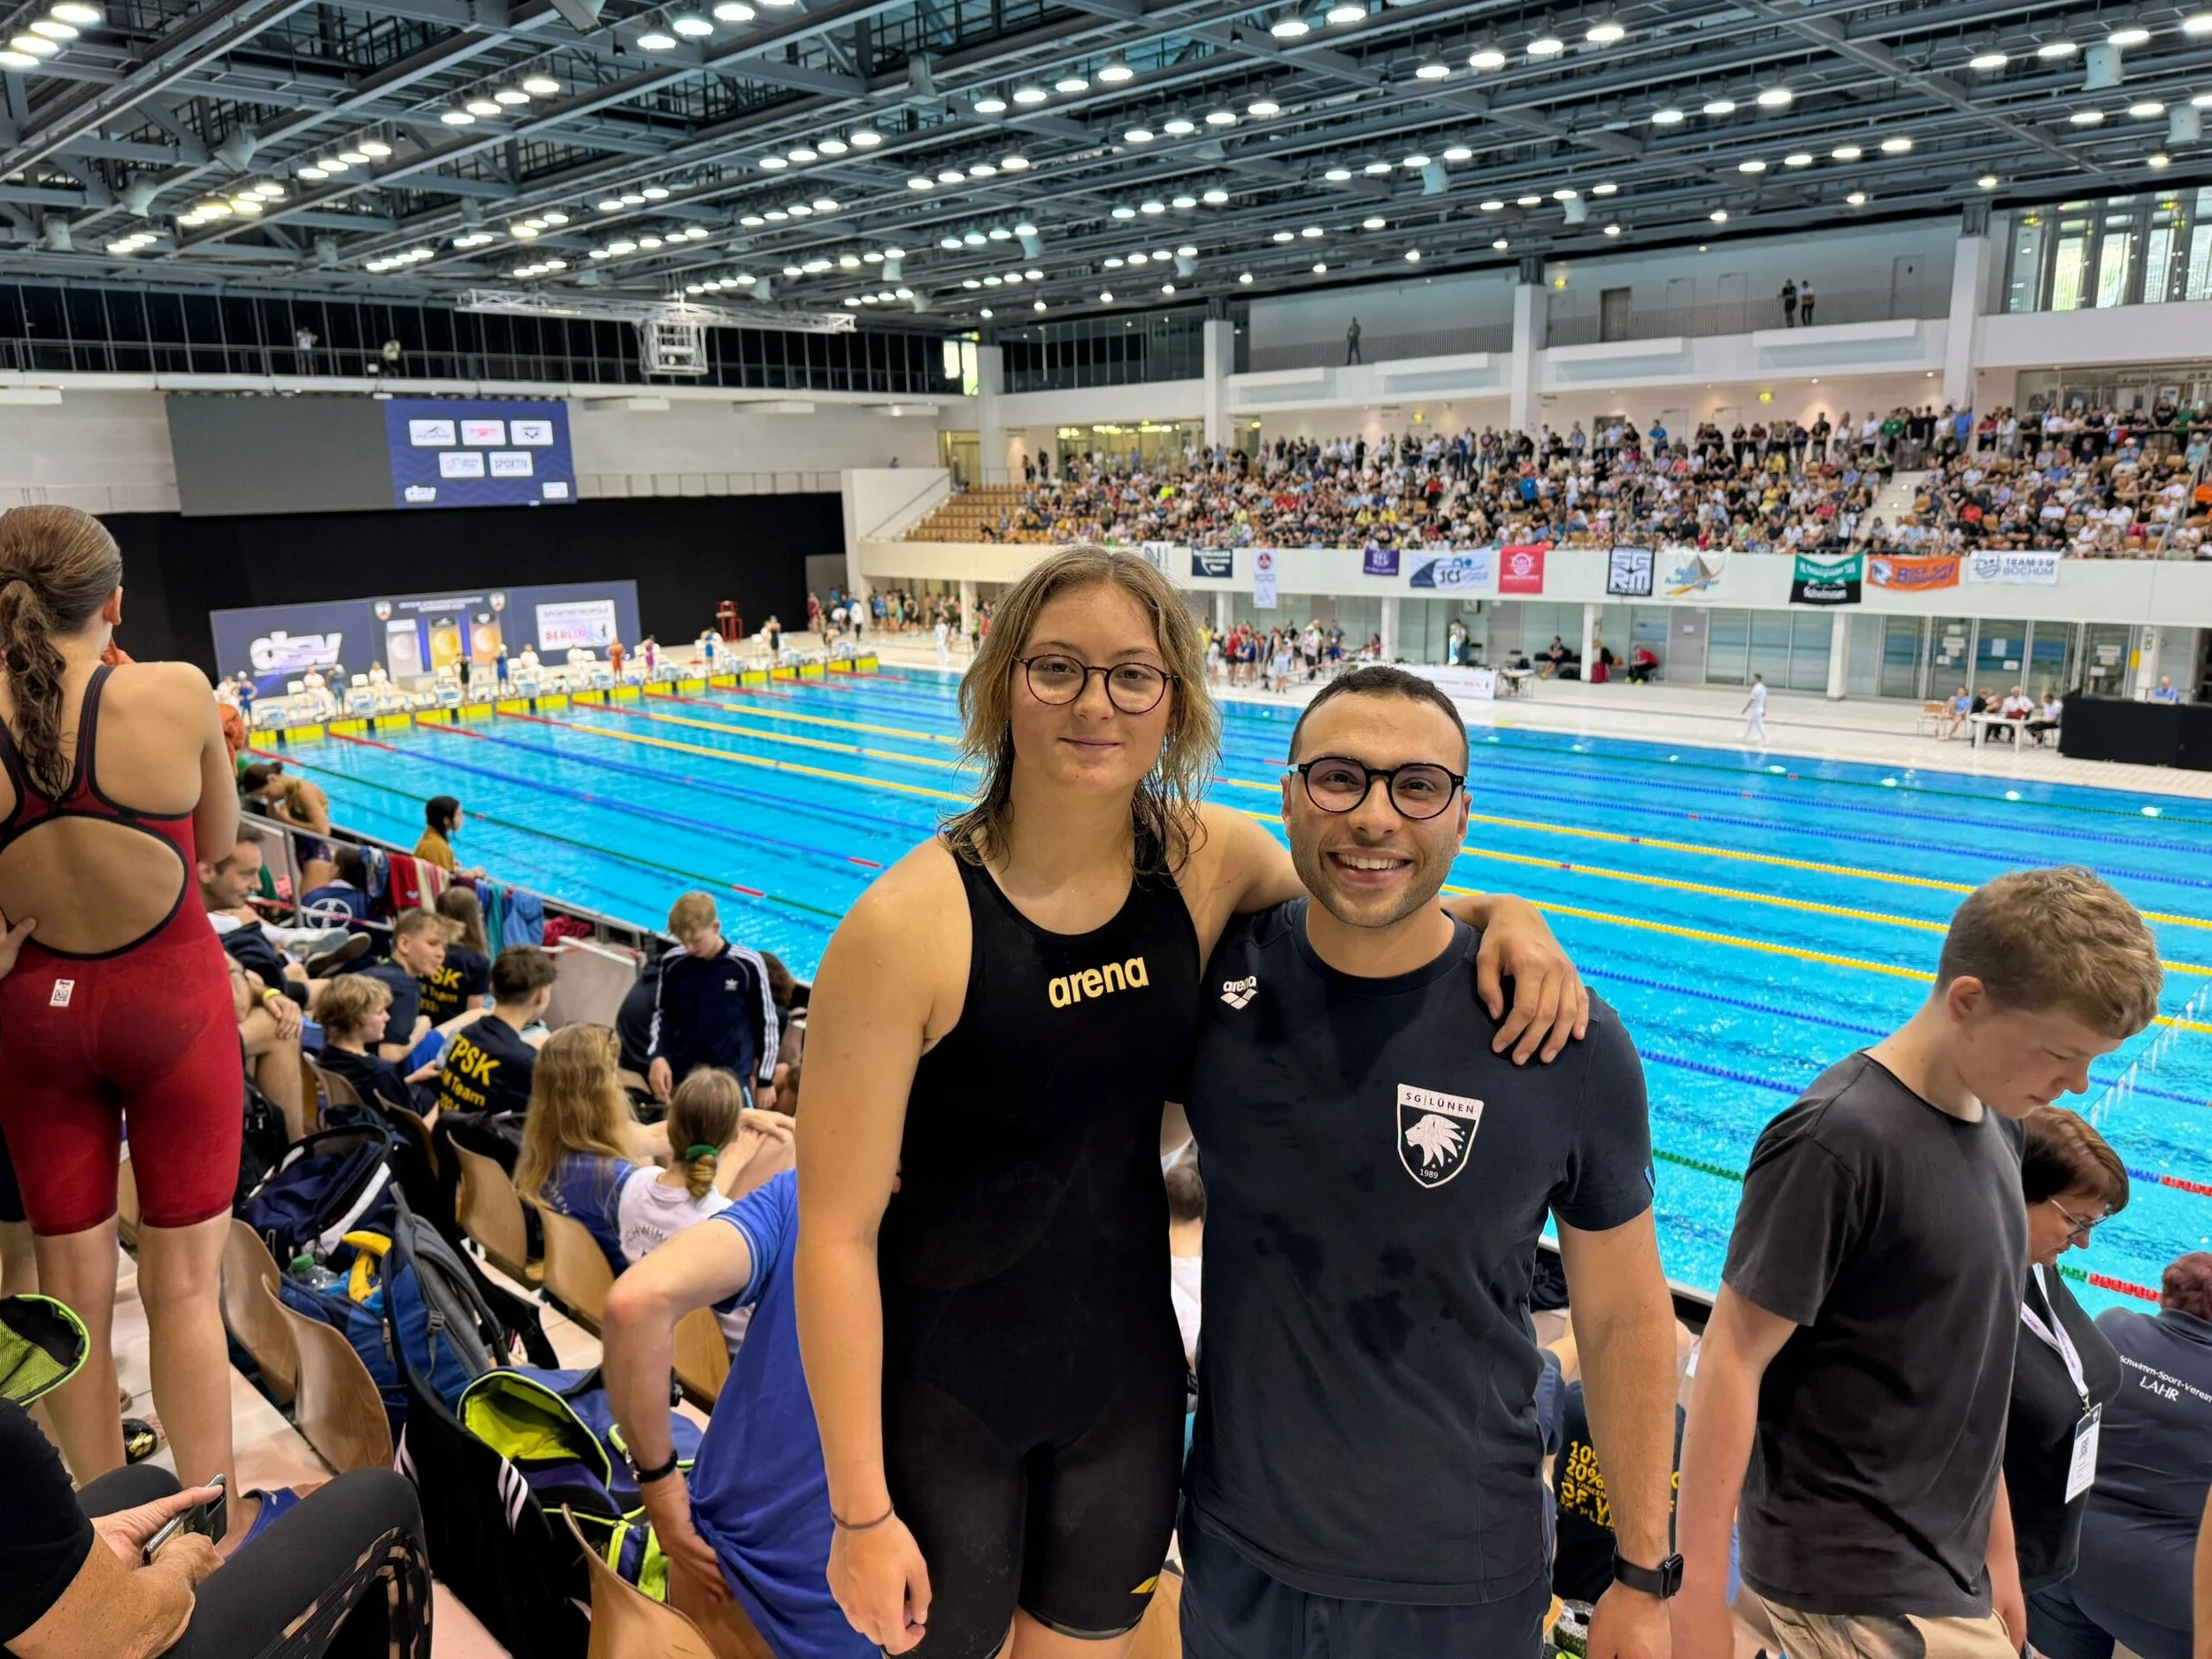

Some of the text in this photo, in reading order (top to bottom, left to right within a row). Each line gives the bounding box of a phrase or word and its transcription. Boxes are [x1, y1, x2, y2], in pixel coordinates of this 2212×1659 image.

[2002, 567, 2054, 576] BOCHUM
[1048, 956, 1149, 1009] arena
[1223, 975, 1256, 993] arena
[451, 1075, 486, 1108] Team
[1429, 1097, 1474, 1114] LÜNEN
[1419, 1168, 1439, 1179] 1989
[2139, 1375, 2180, 1402] LAHR
[1565, 1457, 1604, 1490] 20%
